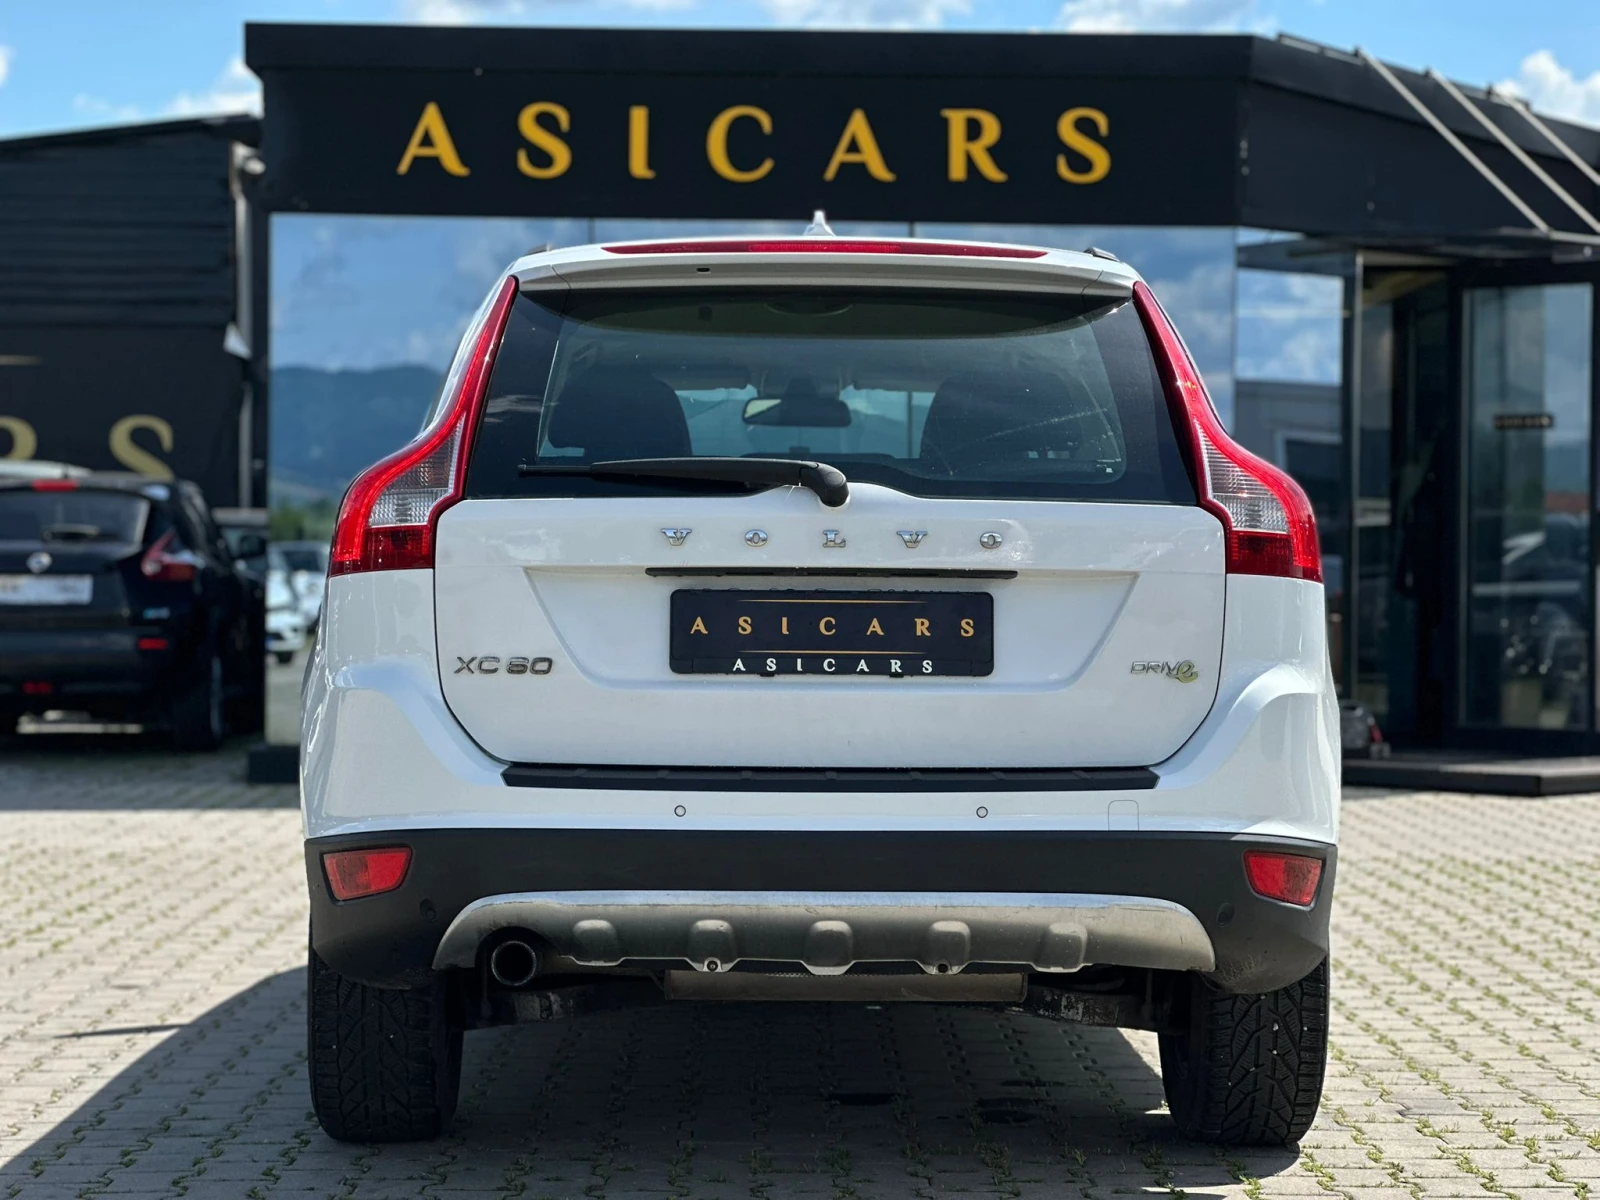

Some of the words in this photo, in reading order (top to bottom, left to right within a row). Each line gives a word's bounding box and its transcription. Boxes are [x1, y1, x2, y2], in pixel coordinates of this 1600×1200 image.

[397, 102, 1112, 185] ASICARS
[660, 528, 1003, 548] VOLVO
[690, 616, 975, 637] ASICARS
[732, 657, 934, 674] ASICARS
